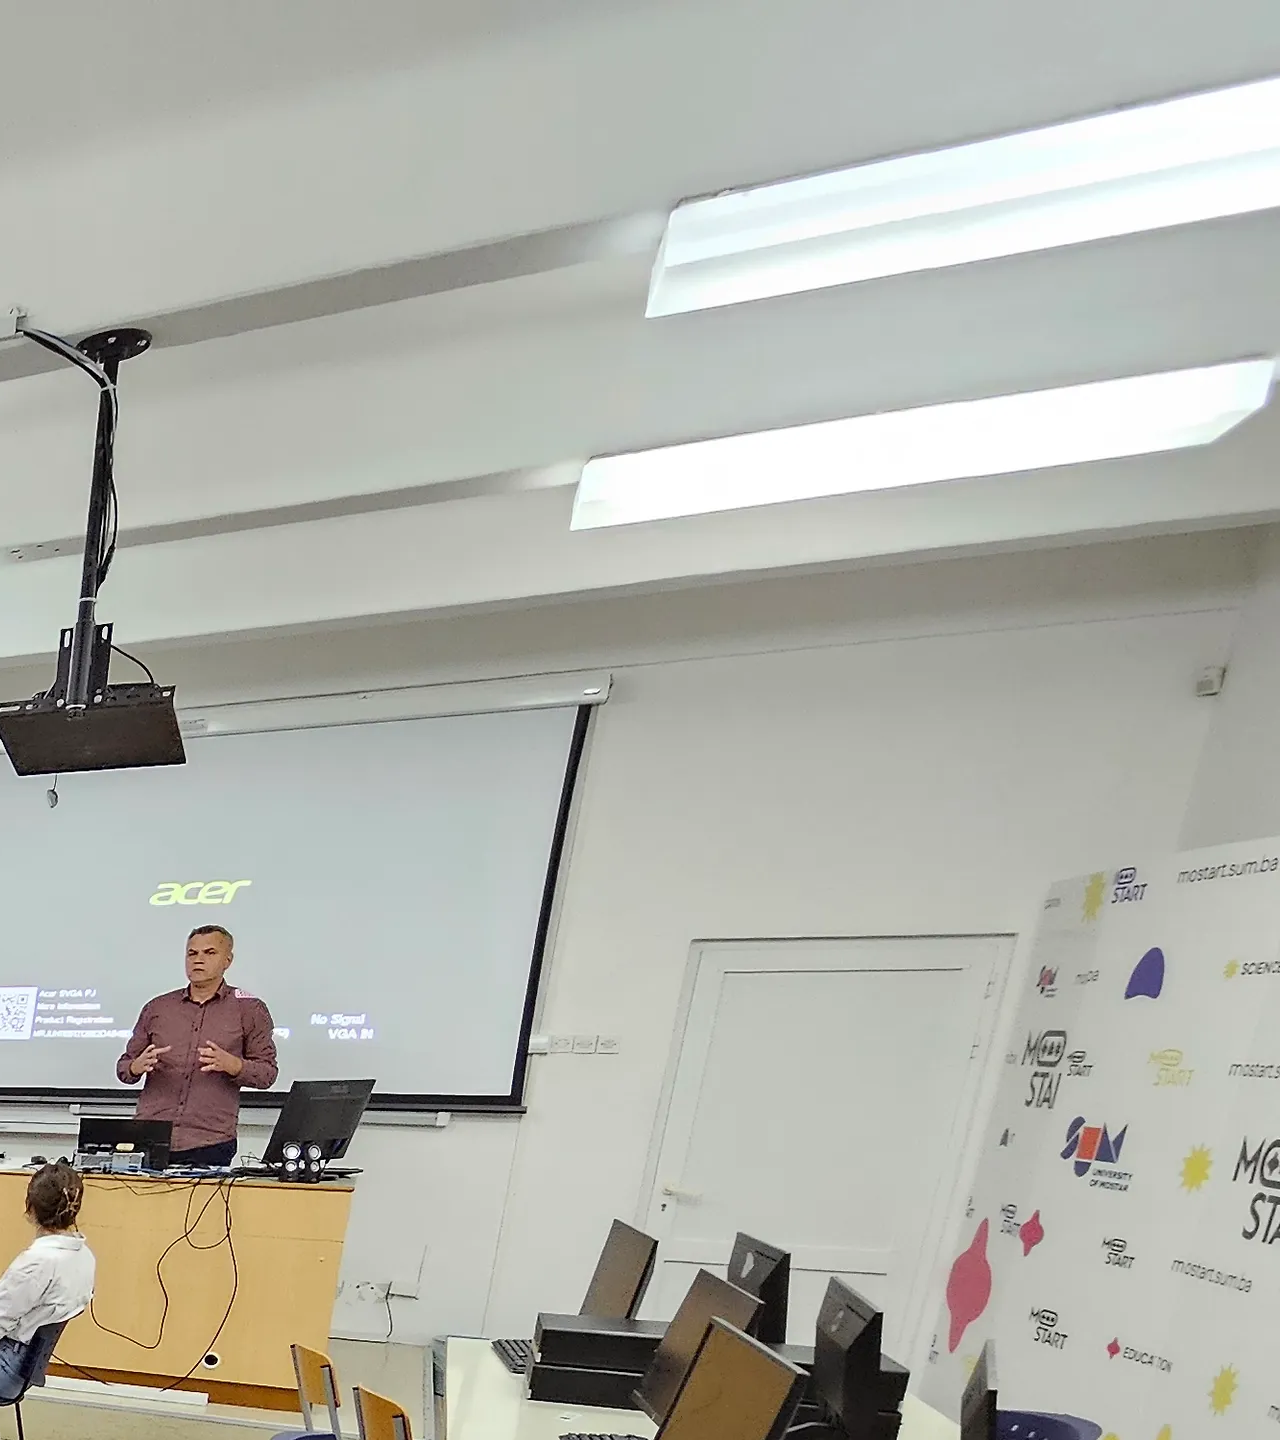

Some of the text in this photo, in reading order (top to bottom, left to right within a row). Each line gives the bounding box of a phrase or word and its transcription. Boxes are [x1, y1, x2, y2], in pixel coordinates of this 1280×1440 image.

[148, 879, 252, 906] acer
[1111, 884, 1148, 904] START
[310, 1014, 366, 1027] No Signal
[328, 1028, 358, 1040] VGA
[1105, 1252, 1135, 1269] START
[1034, 1326, 1068, 1349] START
